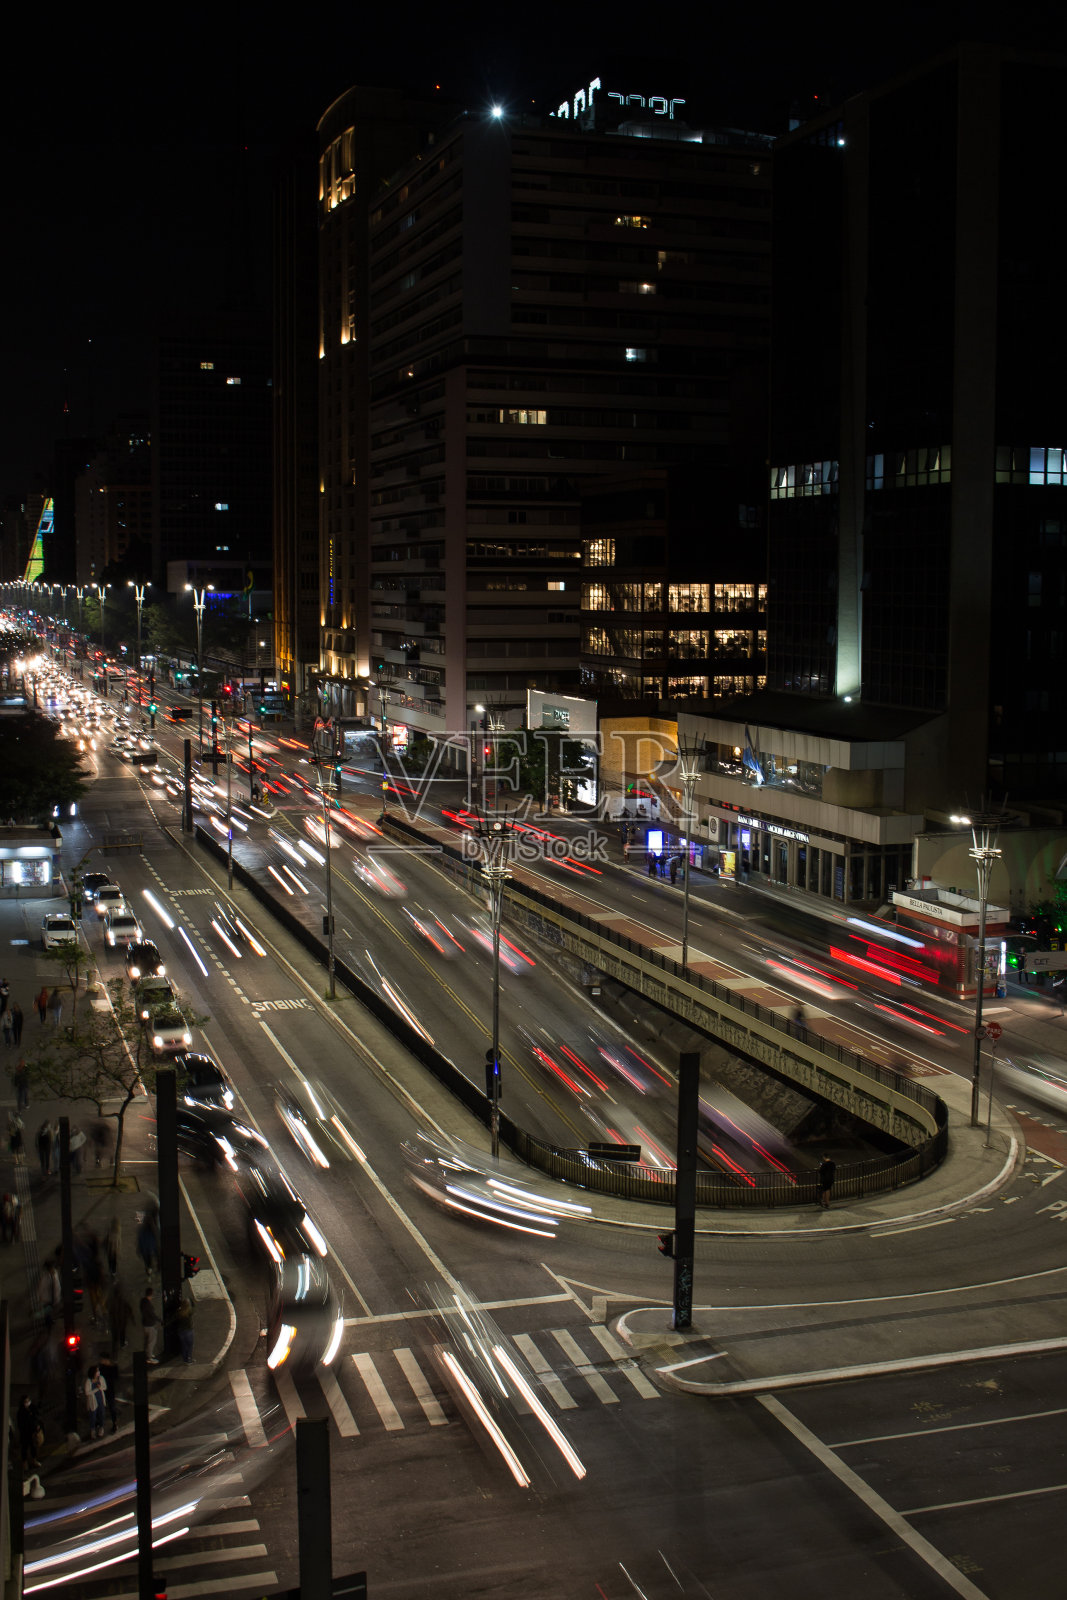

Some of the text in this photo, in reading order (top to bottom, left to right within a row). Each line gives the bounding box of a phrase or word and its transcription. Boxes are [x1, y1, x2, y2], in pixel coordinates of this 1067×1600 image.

[738, 815, 752, 825] BANCO
[784, 829, 810, 843] ARGENTINA
[909, 898, 922, 908] BELLA
[923, 904, 943, 915] PAULISTA
